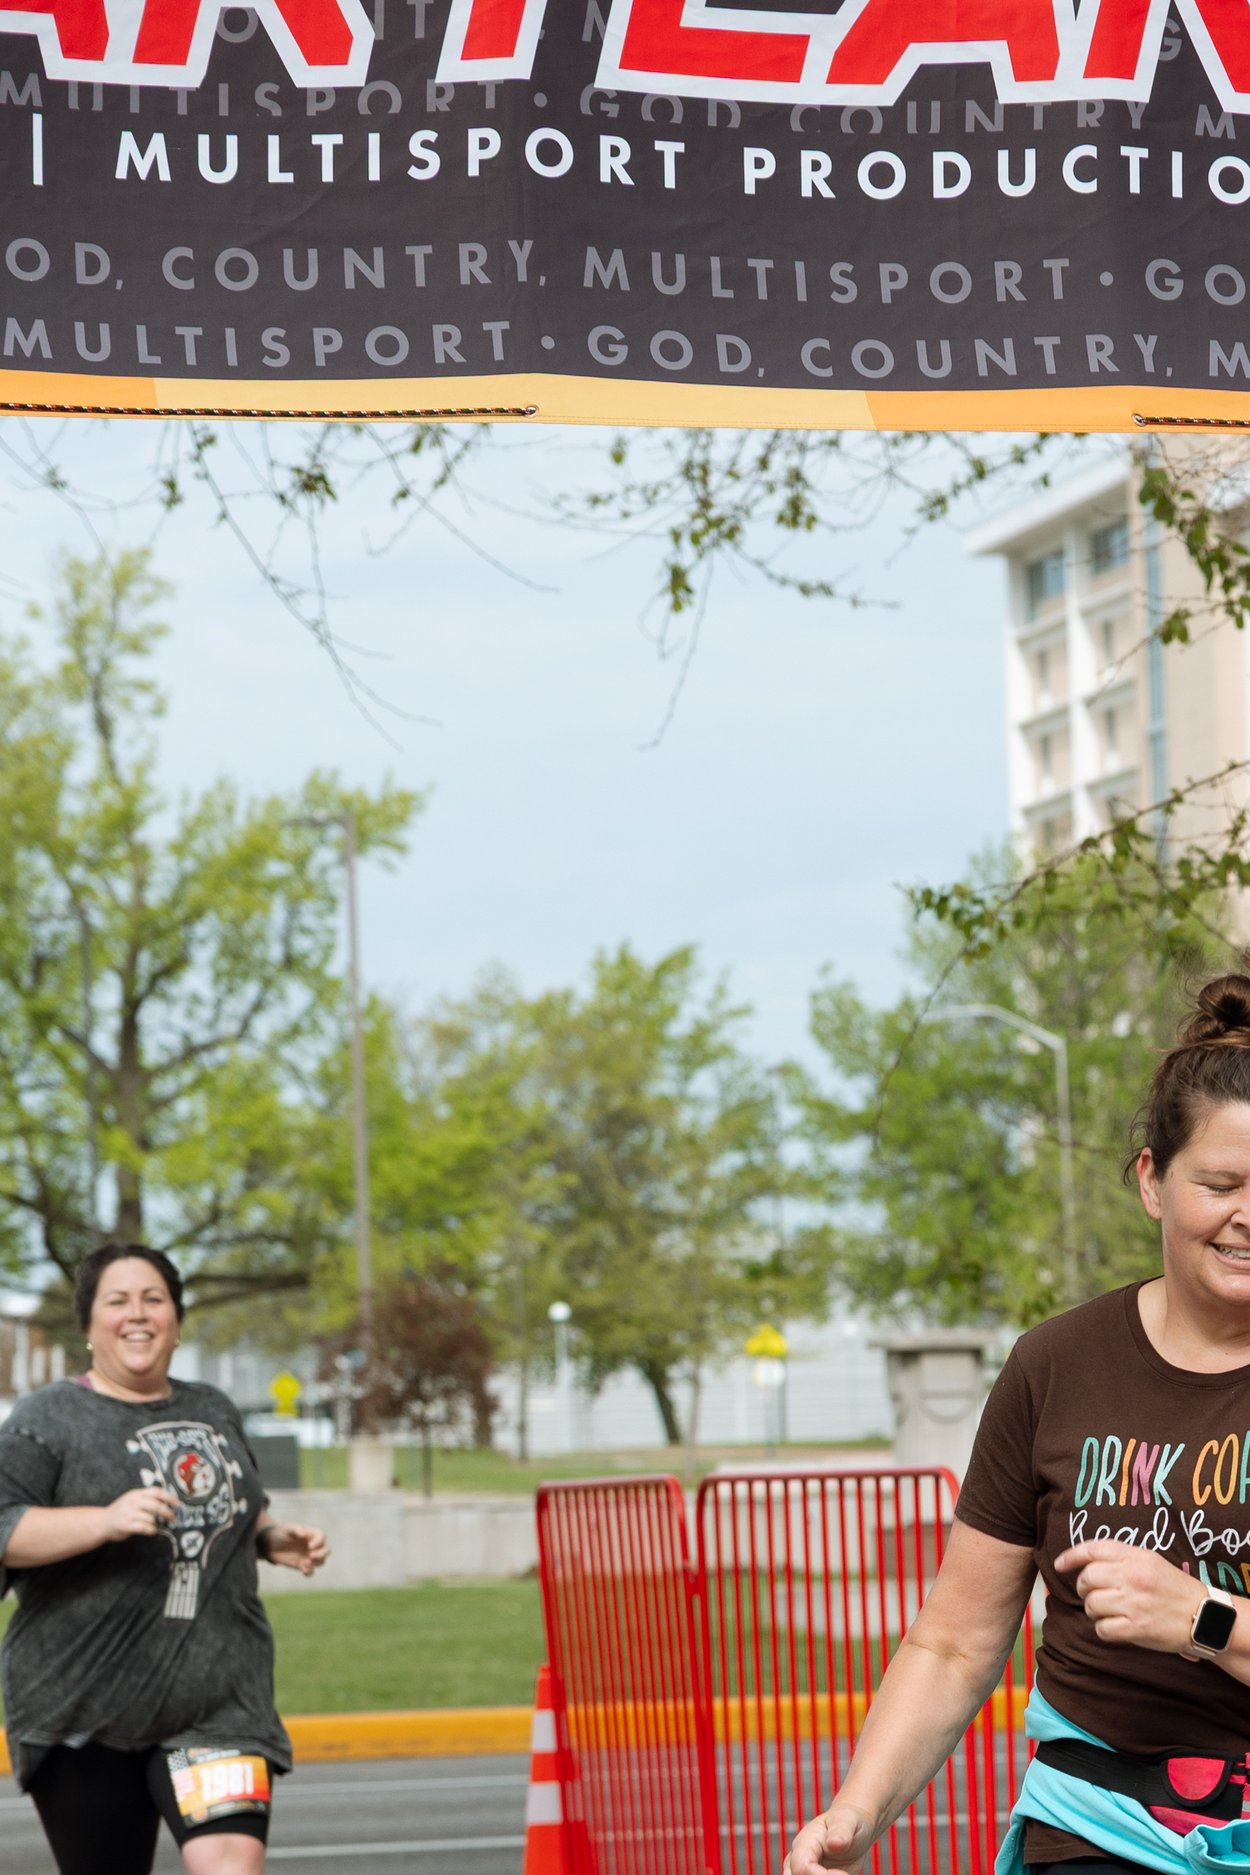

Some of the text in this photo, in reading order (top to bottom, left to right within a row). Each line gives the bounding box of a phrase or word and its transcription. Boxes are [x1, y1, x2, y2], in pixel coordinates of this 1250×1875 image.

[116, 128, 685, 189] MULTISPORT
[161, 239, 547, 293] COUNTRY,
[583, 246, 1070, 305] MULTISPORT
[2, 316, 511, 369] MULTISPORT
[586, 324, 766, 379] GOD,
[799, 333, 1174, 380] COUNTRY,
[1074, 1434, 1186, 1508] DRINK
[1069, 1506, 1176, 1551] Read
